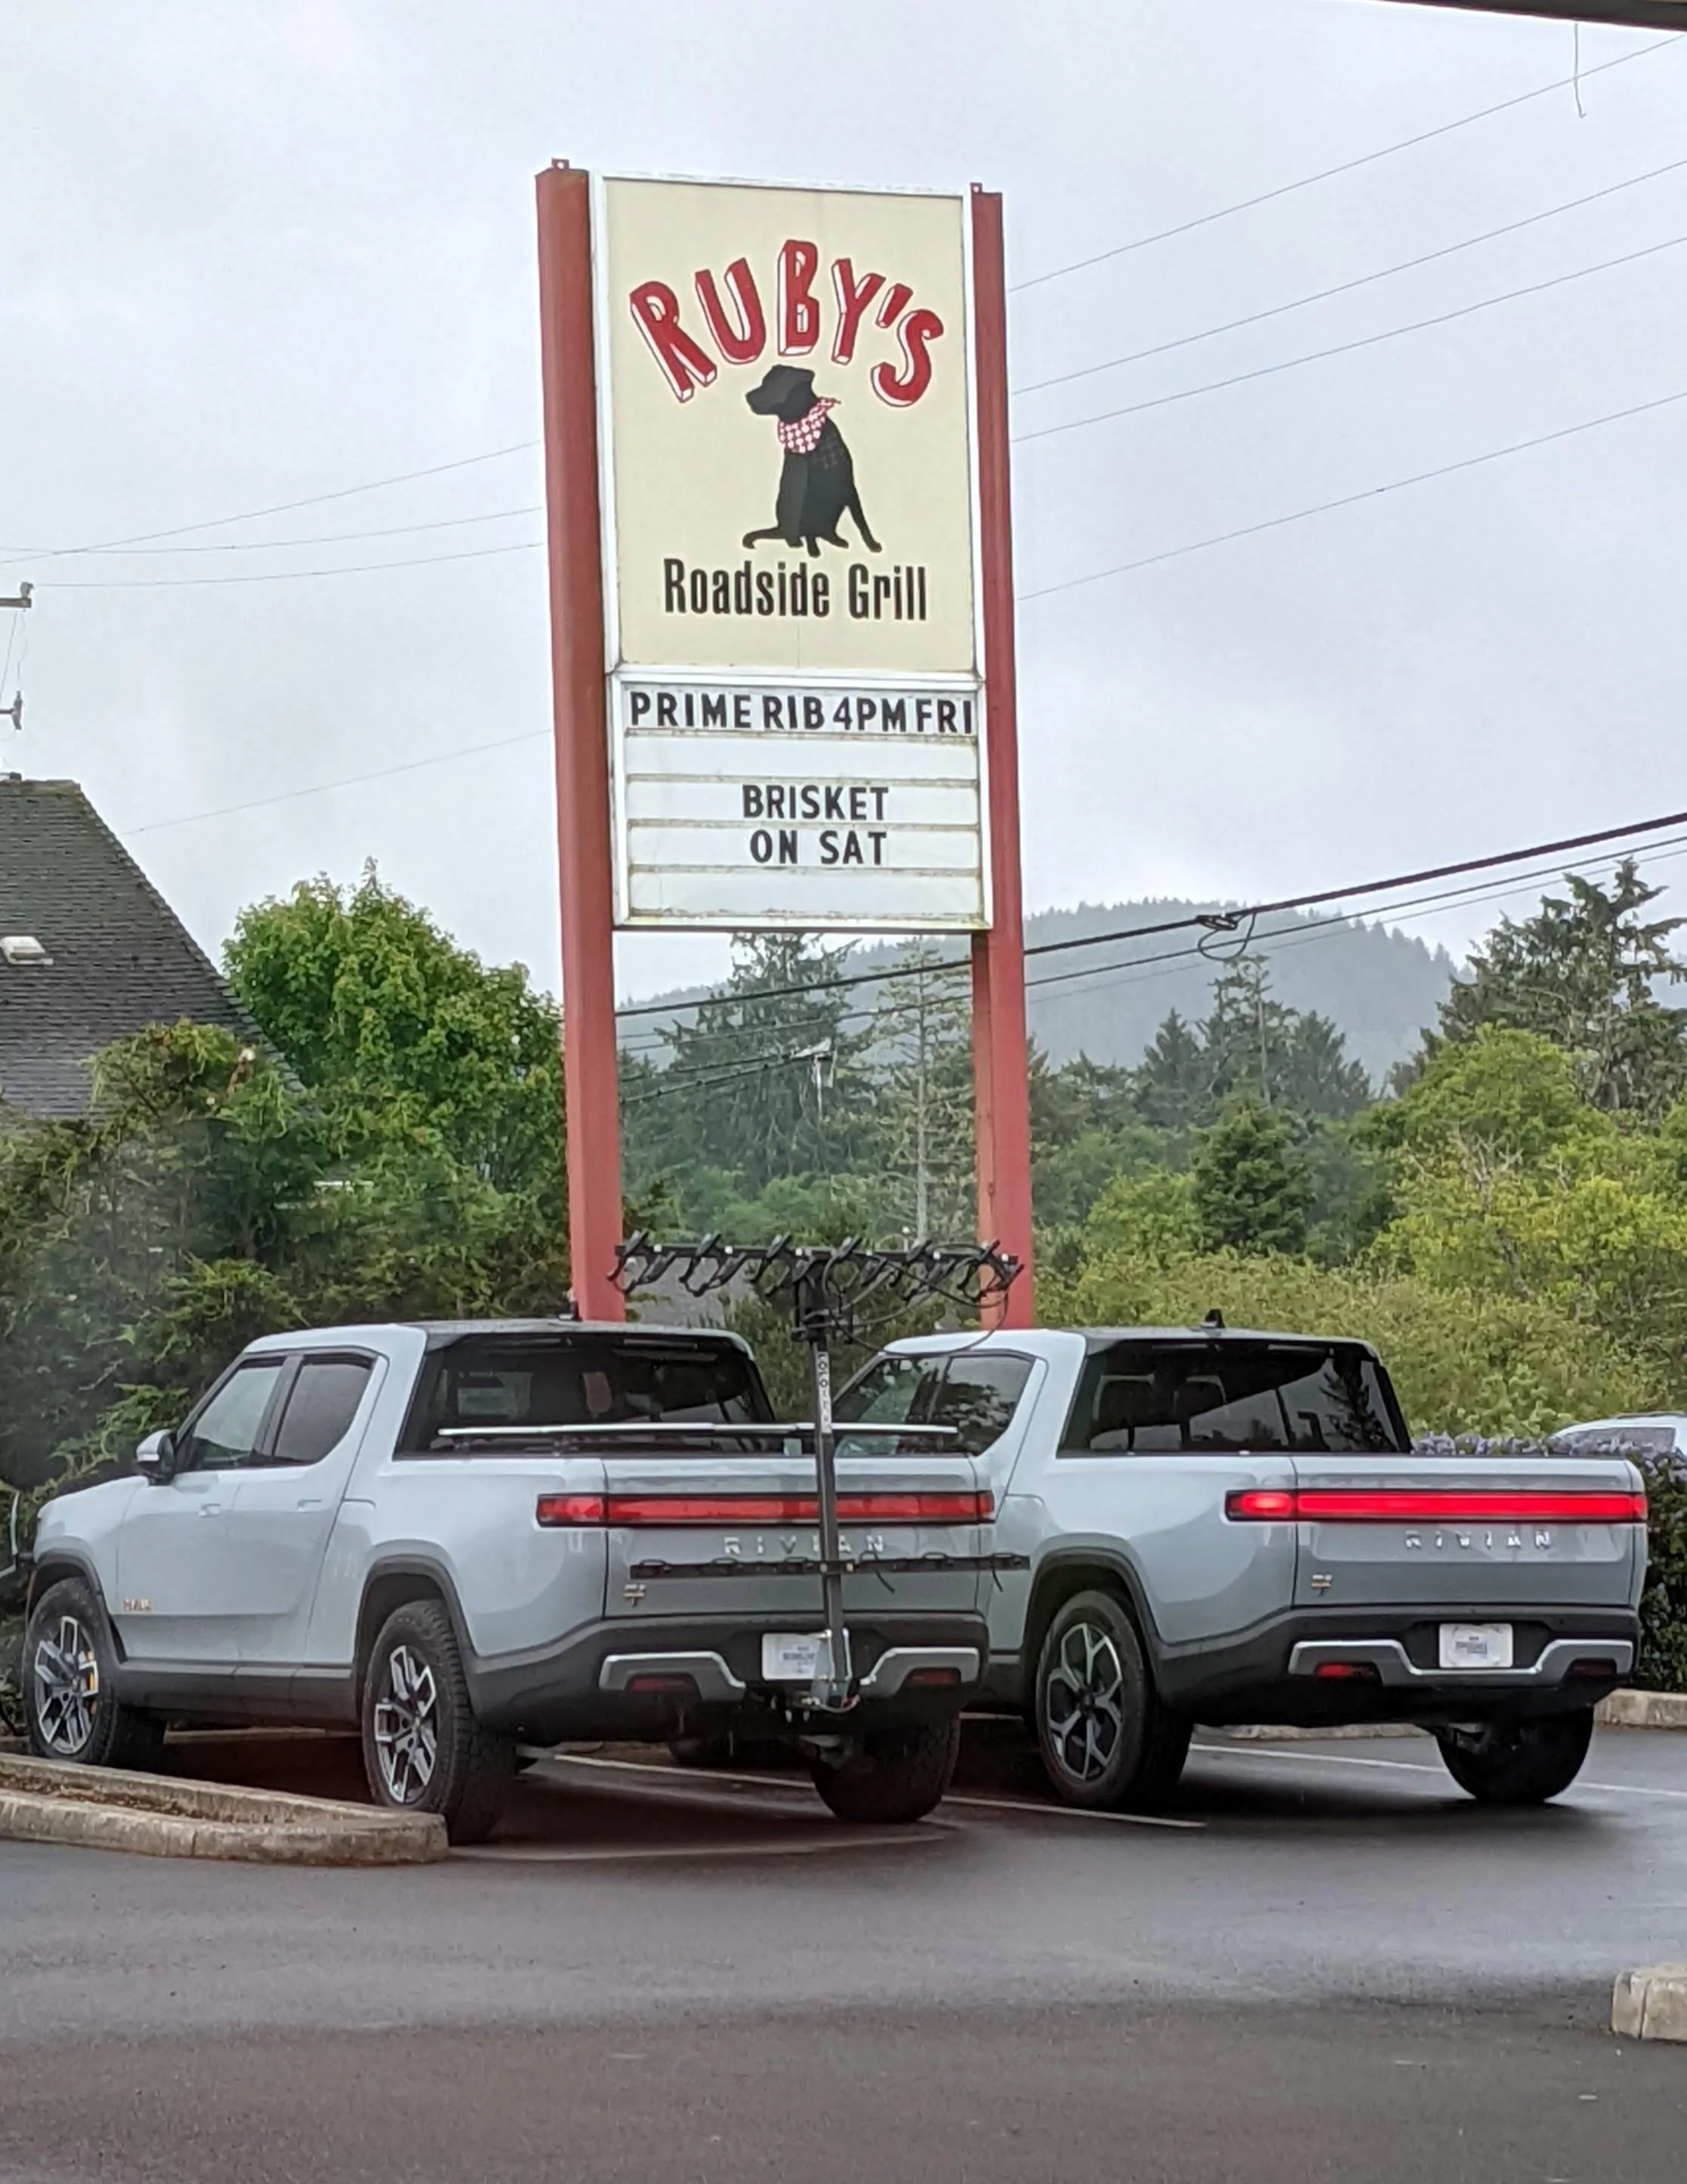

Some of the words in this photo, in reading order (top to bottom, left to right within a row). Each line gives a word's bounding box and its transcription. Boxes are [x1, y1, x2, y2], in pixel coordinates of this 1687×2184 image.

[628, 239, 945, 408] RUBY'S
[664, 558, 830, 617] Roadside
[849, 563, 926, 621] Grill
[630, 692, 751, 729] PRIME
[762, 695, 825, 730] RIB
[833, 698, 906, 732] 4PM
[916, 698, 972, 735] FRI
[742, 784, 889, 821] BRISKET
[750, 830, 797, 864] ON
[819, 830, 887, 865] SAT
[723, 1535, 884, 1554] RIVIAN
[1404, 1529, 1552, 1550] RIVIAN
